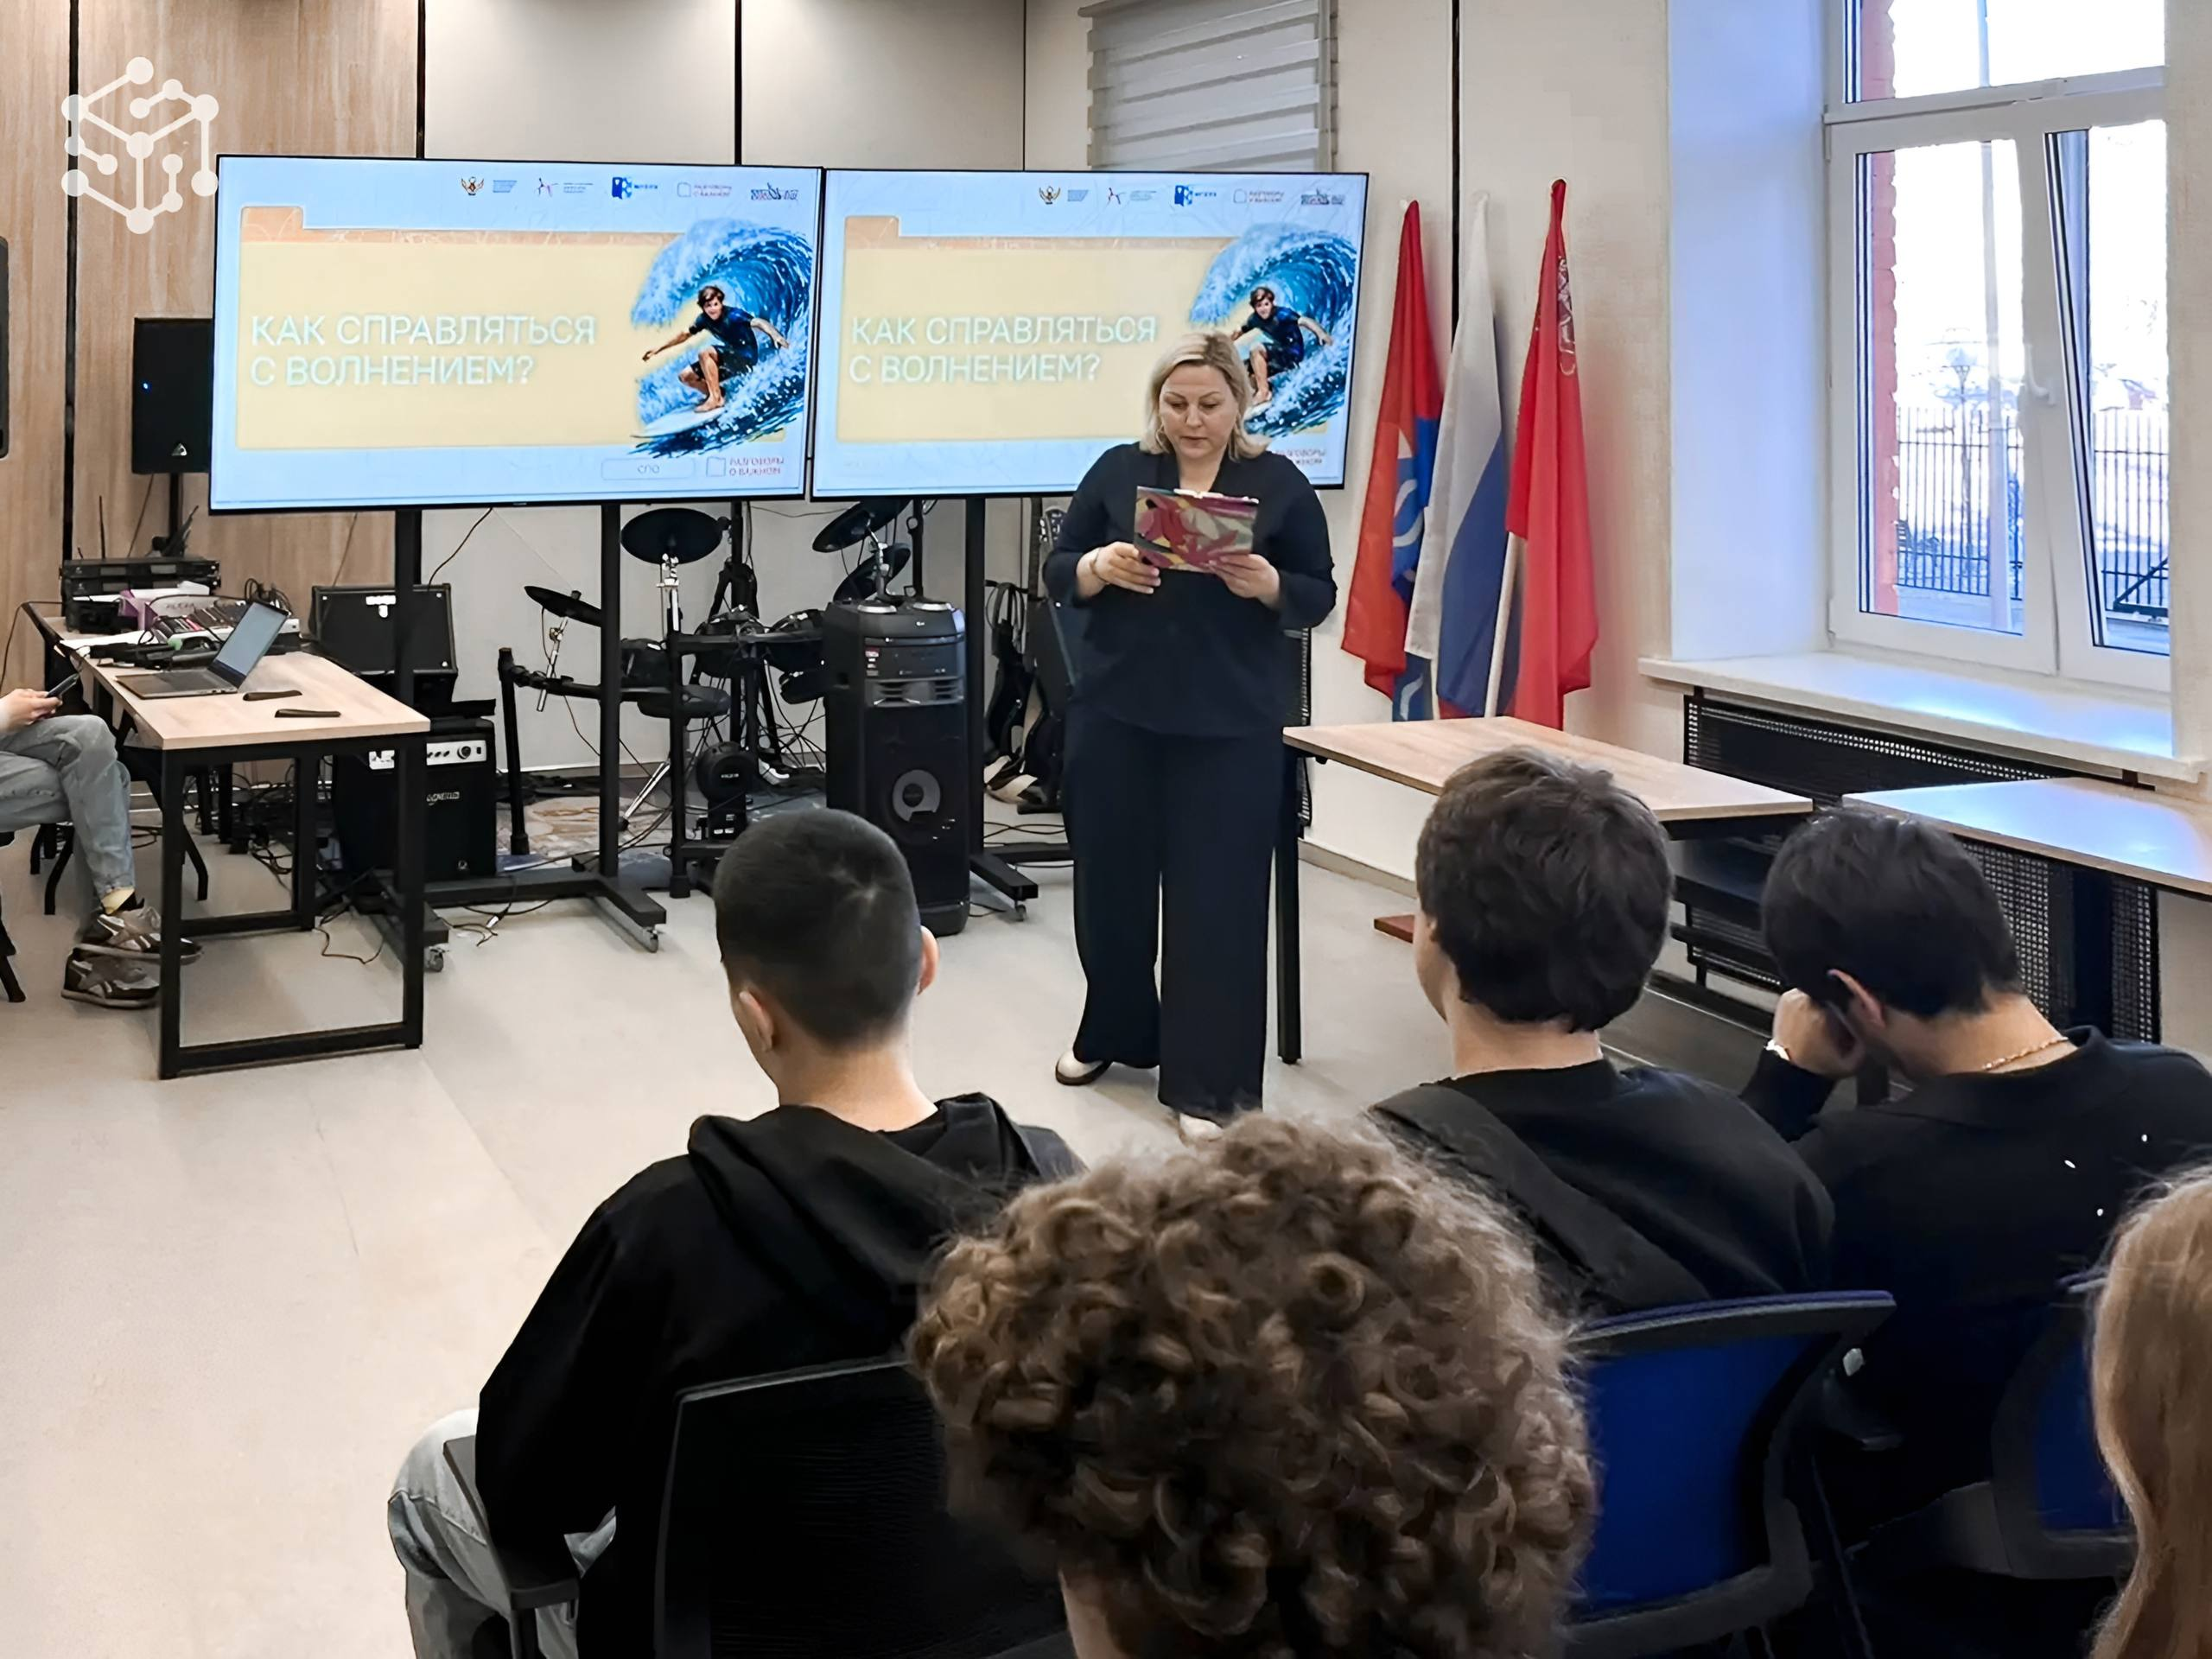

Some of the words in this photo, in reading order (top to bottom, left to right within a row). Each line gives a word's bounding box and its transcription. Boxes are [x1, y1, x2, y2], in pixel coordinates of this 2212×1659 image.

[251, 315, 326, 346] КАК
[336, 315, 596, 346] СПРАВЛЯТЬСЯ
[852, 317, 916, 345] КАК
[925, 316, 1157, 345] СПРАВЛЯТЬСЯ
[250, 356, 276, 387] С
[285, 355, 534, 386] ВОЛНЕНИЕМ?
[849, 355, 872, 384] С
[880, 354, 1101, 384] ВОЛНЕНИЕМ?
